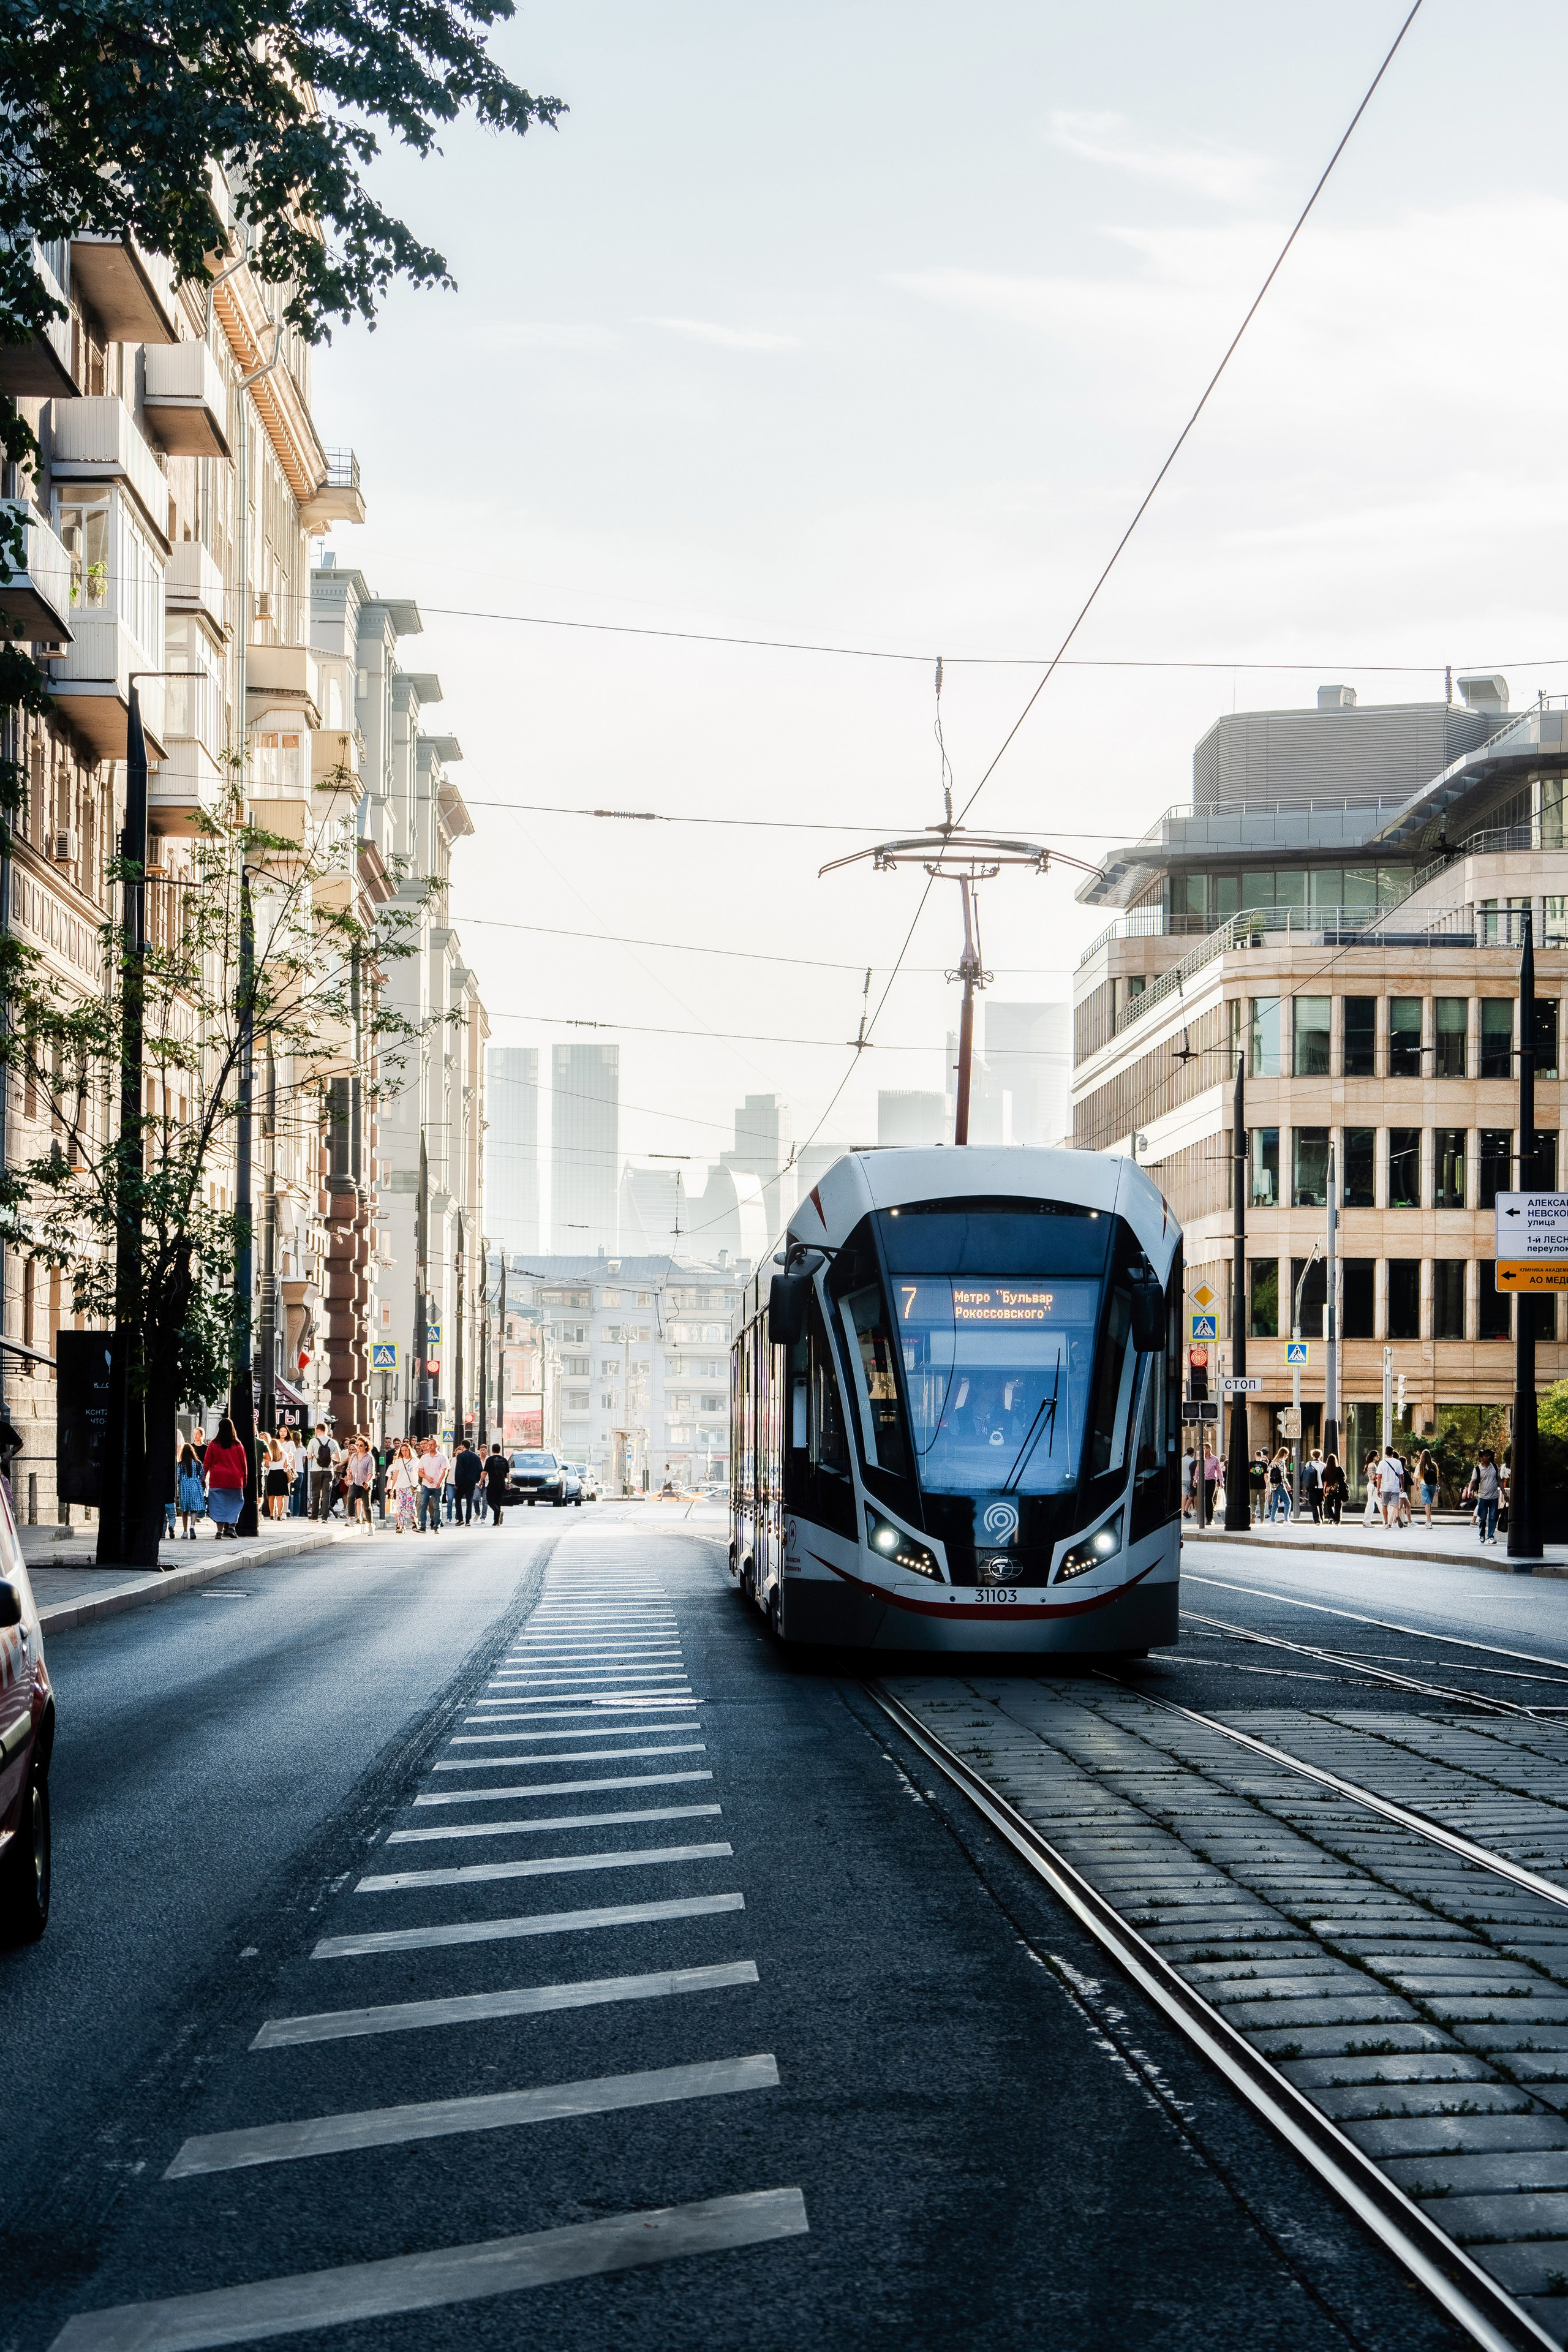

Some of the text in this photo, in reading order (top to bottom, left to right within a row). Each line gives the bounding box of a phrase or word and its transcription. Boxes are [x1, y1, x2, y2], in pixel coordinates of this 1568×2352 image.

[902, 1287, 917, 1319] 7
[954, 1289, 1053, 1305] Метро "Бульвар
[955, 1306, 1051, 1319] Рокоссовского"
[1224, 1379, 1256, 1390] СТОП
[974, 1589, 1017, 1603] 31103
